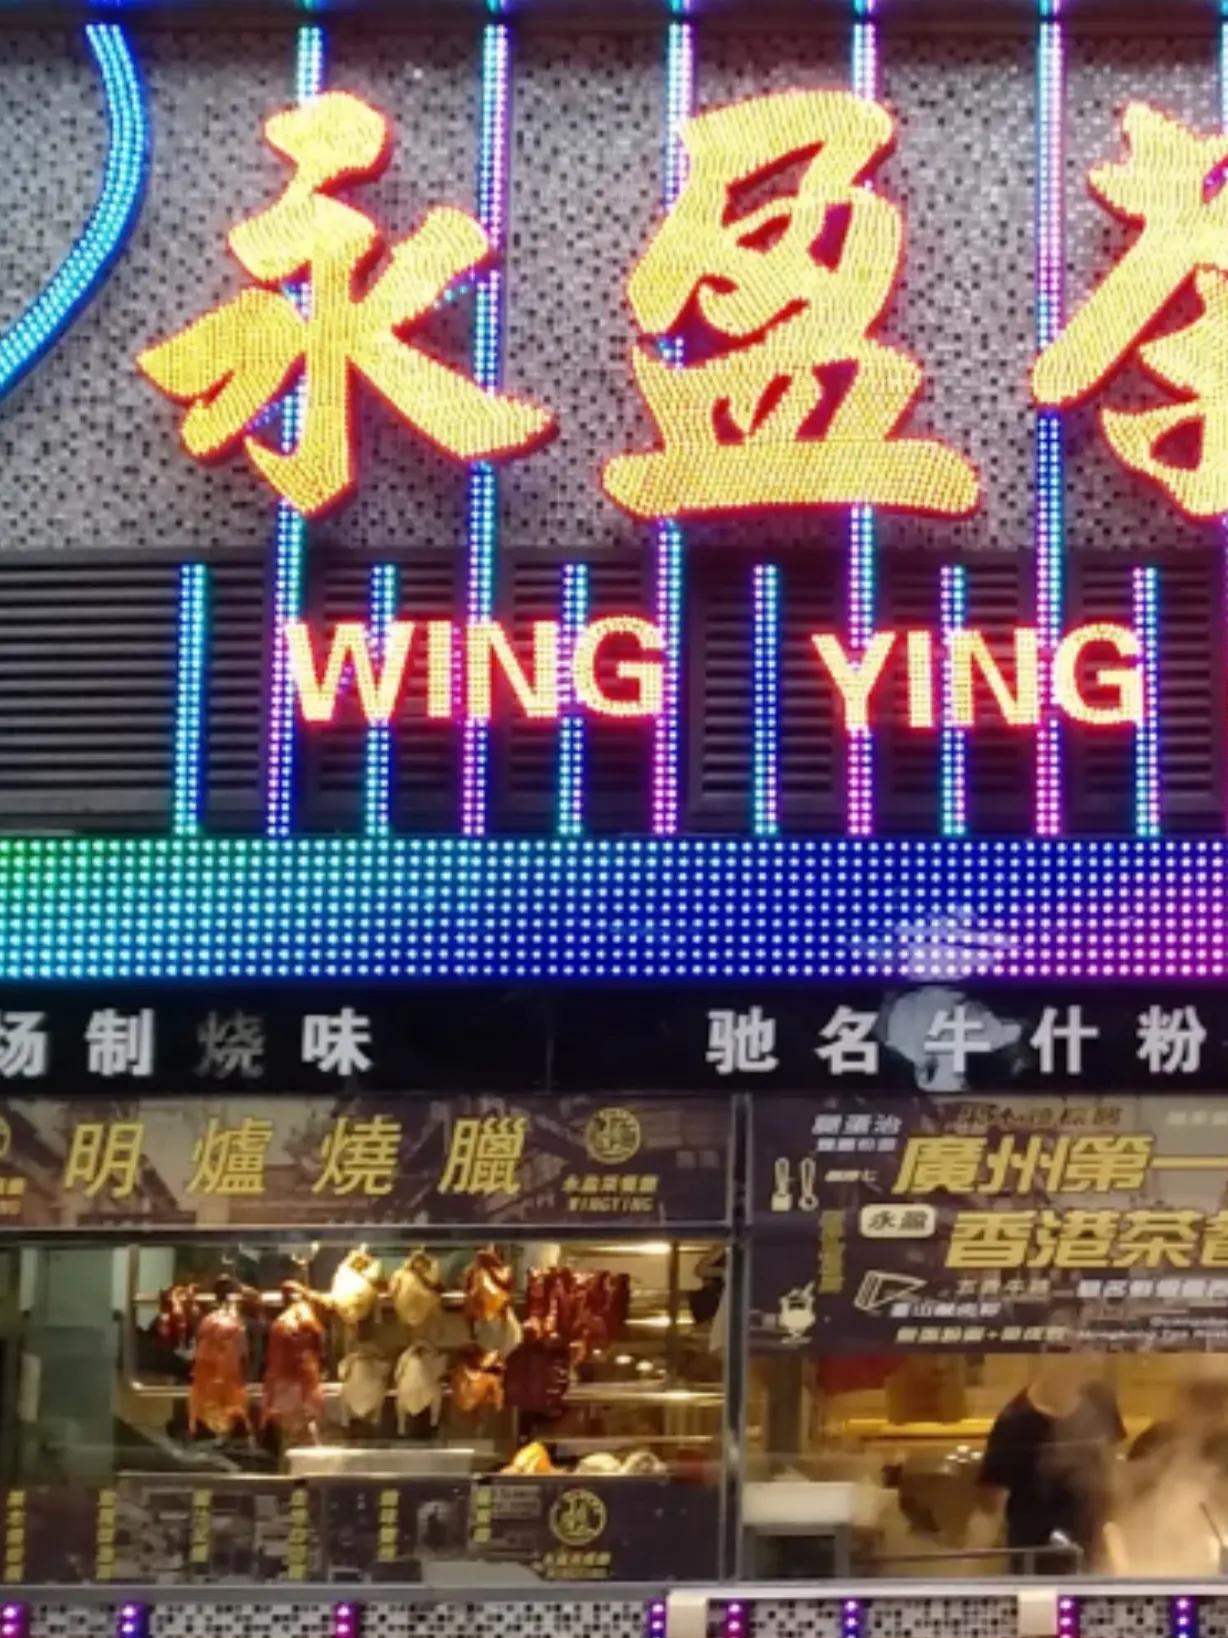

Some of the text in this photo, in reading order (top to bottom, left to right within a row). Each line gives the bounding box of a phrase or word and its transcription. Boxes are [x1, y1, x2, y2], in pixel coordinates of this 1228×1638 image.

[285, 616, 668, 724] WING
[812, 622, 1146, 731] YING
[63, 1116, 531, 1199] 明爐燒臘
